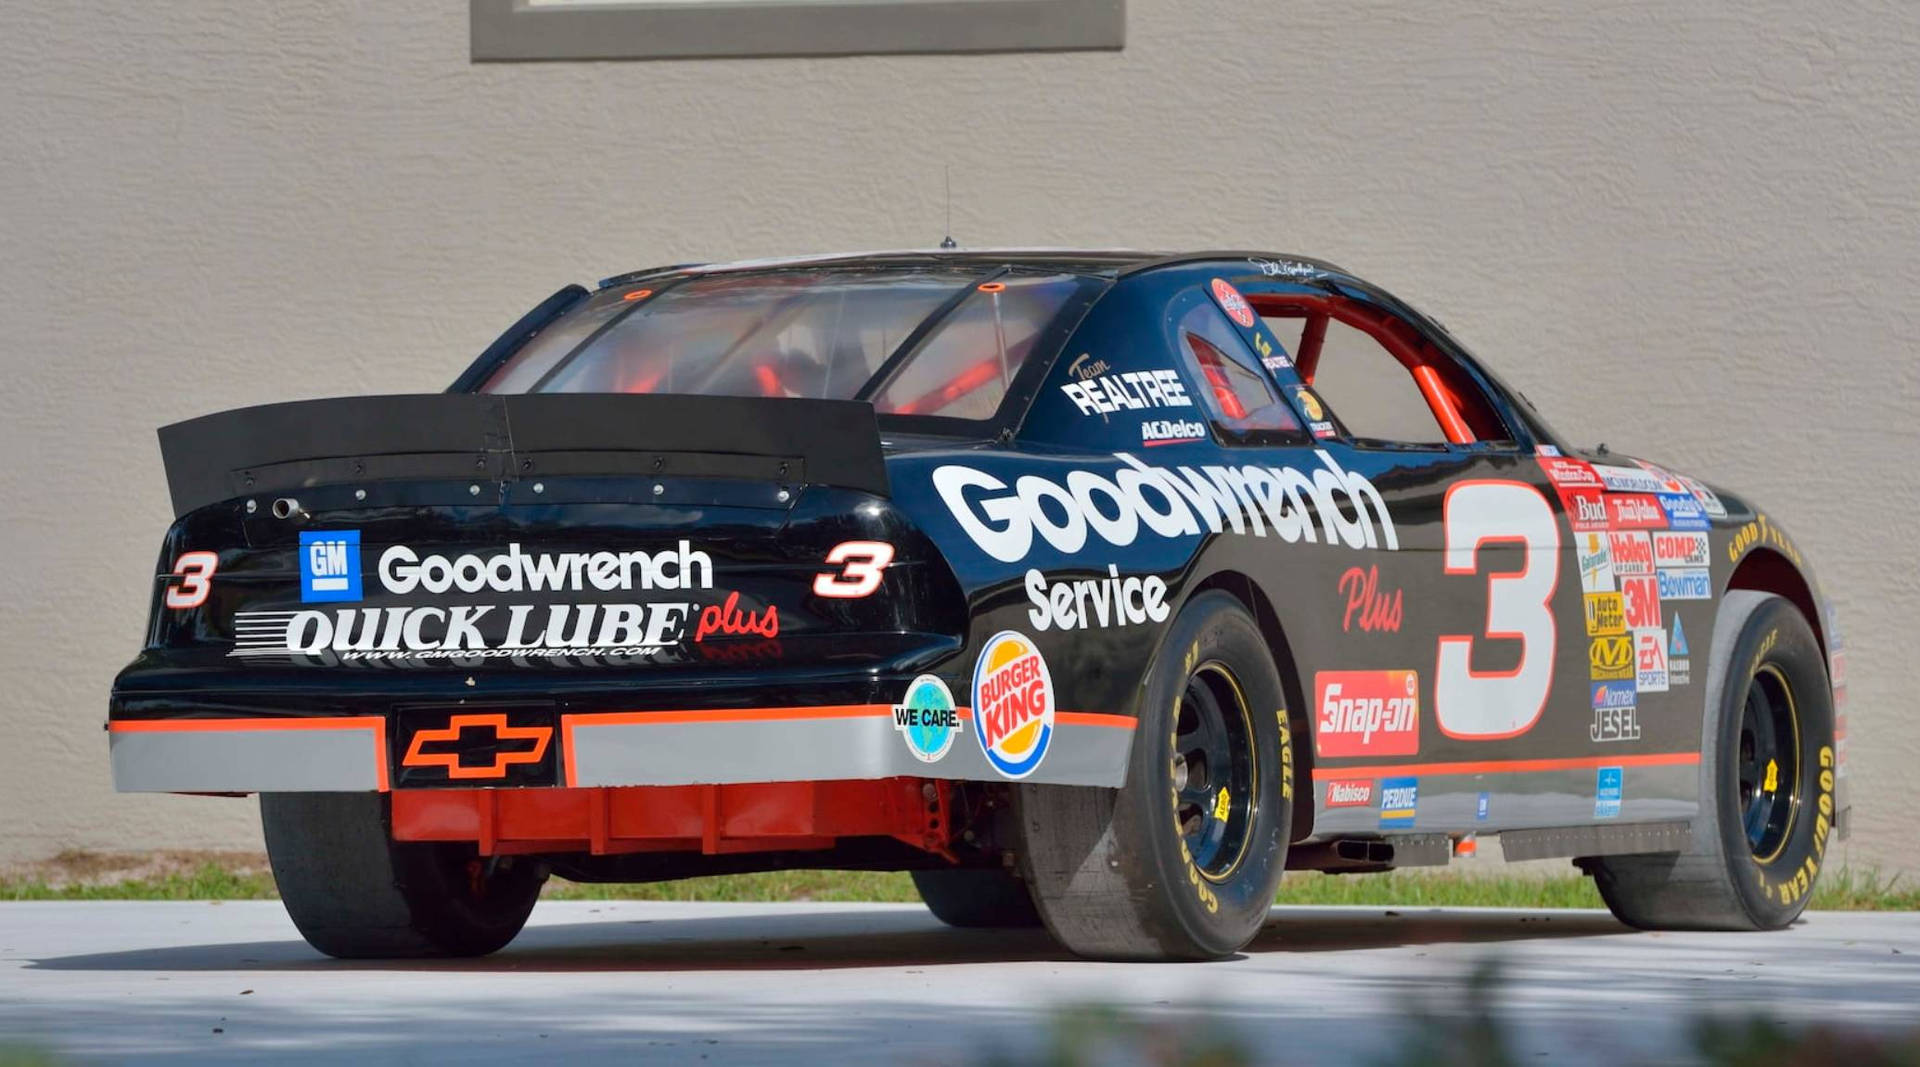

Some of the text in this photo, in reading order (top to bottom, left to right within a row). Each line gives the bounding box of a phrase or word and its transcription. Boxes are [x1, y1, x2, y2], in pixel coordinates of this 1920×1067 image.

[1069, 353, 1110, 381] Team
[1061, 370, 1193, 416] REALTREE
[1142, 419, 1205, 440] ACDelco
[932, 449, 1399, 563] Goodwrench
[1576, 495, 1607, 521] Bud
[1609, 534, 1653, 572] Holley
[1656, 536, 1695, 560] COMP
[1729, 522, 1758, 563] GOOD
[166, 551, 218, 609] 3
[309, 540, 713, 594] GM Goodwrench
[812, 541, 895, 599] 3
[1659, 571, 1709, 598] Bowman
[1025, 564, 1171, 631] Service
[1339, 564, 1404, 632] Plus
[1434, 479, 1562, 740] 3
[1624, 578, 1660, 628] 3M
[286, 591, 779, 655] QUICK LUBE plus
[341, 646, 662, 661] WWW.GMGOODWRENCH.COM
[981, 655, 1040, 711] BURGER
[1639, 671, 1666, 686] SPORTS
[896, 709, 918, 726] WE
[986, 680, 1046, 747] KING
[1320, 683, 1416, 744] Snap-on
[1591, 708, 1640, 741] JESEL
[1276, 709, 1294, 802] EAGLE
[1333, 784, 1371, 803] Nabisco
[1382, 787, 1416, 809] PERDUE
